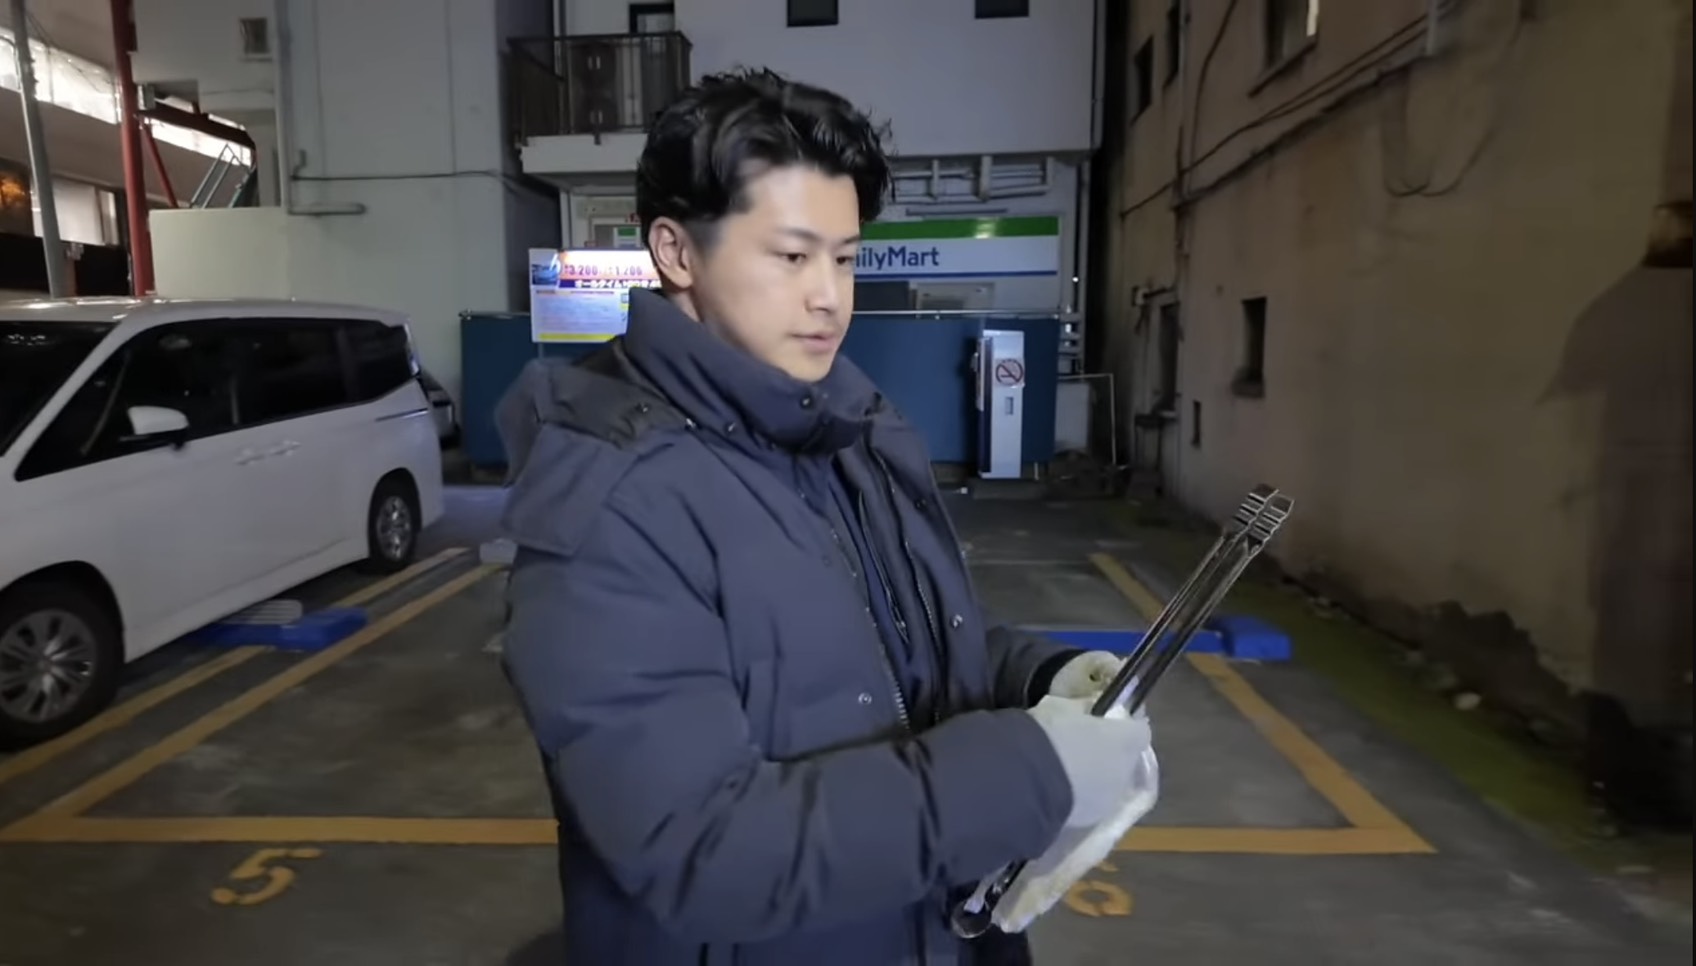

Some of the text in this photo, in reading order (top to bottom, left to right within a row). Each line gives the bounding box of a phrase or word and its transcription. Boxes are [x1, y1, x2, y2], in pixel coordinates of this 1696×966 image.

[856, 246, 939, 270] ilyMart
[211, 848, 323, 905] 5
[1064, 860, 1132, 917] 6
